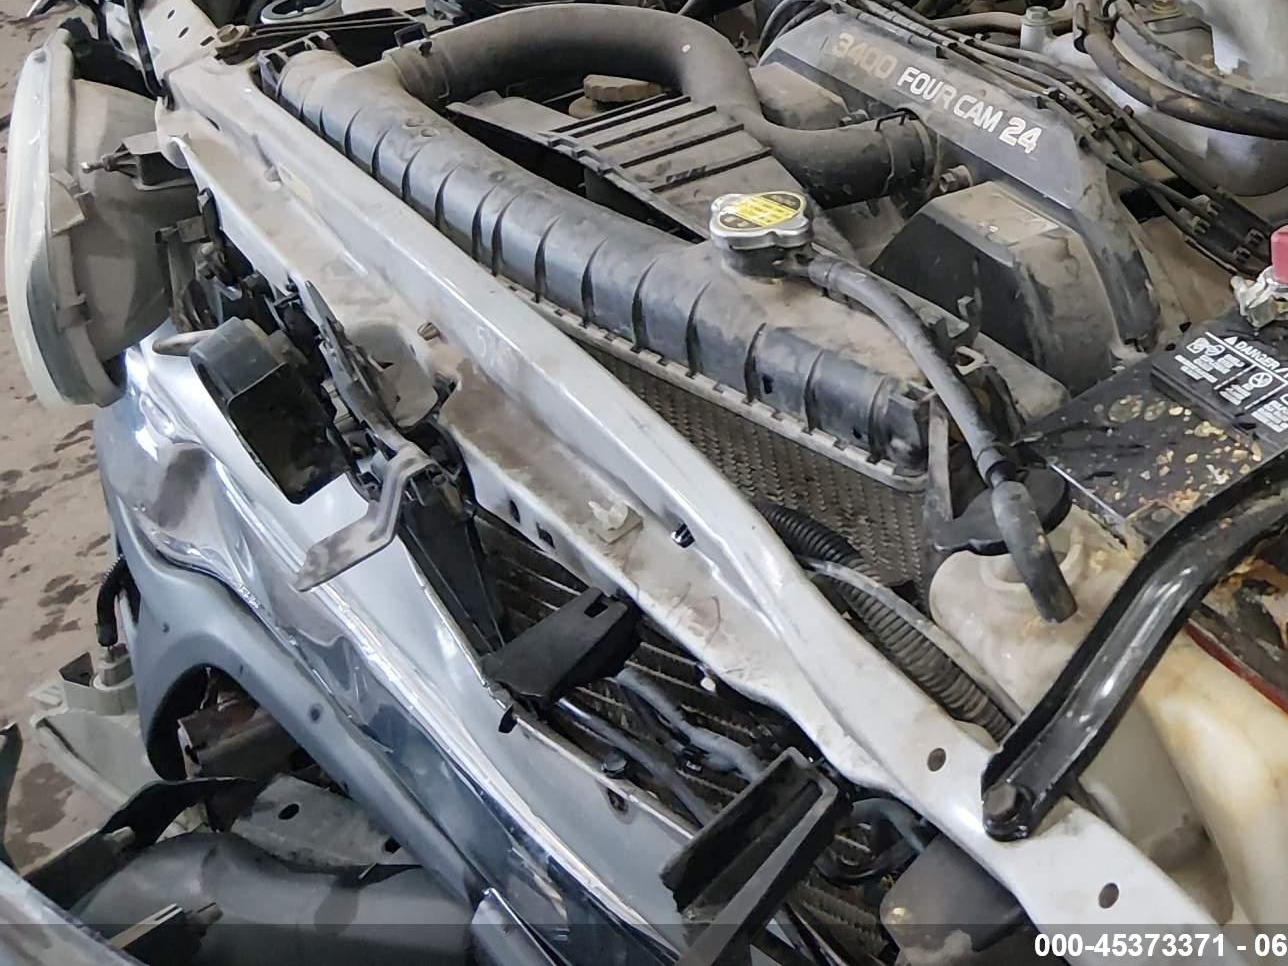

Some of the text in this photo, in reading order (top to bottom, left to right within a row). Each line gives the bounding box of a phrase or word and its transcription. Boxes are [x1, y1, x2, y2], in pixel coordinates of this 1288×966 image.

[832, 32, 1042, 154] 3400 FOUR CAM 24
